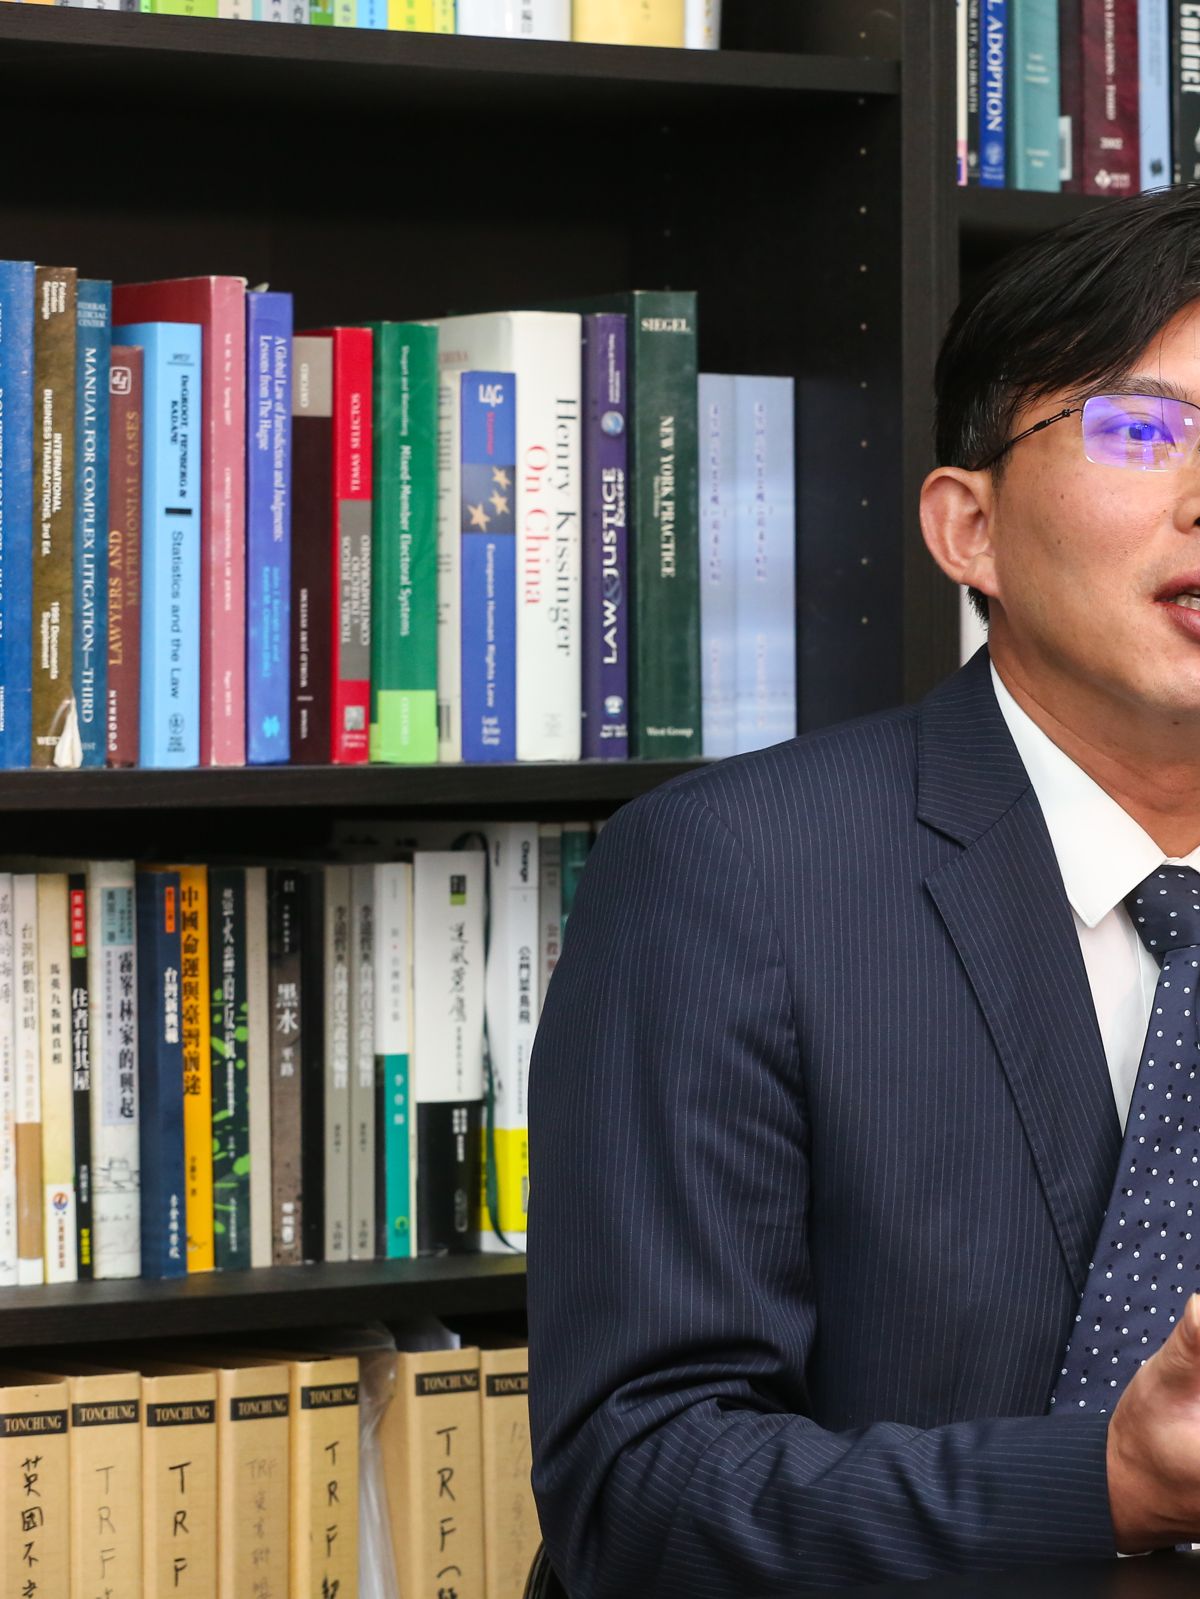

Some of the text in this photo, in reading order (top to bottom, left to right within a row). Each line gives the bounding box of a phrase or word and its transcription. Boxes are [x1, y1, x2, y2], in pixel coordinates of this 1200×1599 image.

[987, 15, 1003, 132] ADOPTION
[50, 281, 59, 313] Gordon
[58, 281, 67, 313] Folsom
[274, 335, 286, 345] A
[274, 346, 287, 379] Global
[84, 347, 97, 425] MANUAL
[256, 335, 272, 451] Lessons from The Hague
[274, 380, 286, 399] Law
[274, 402, 287, 413] of
[300, 363, 310, 408] OXFORD
[84, 430, 97, 462] FOR
[170, 400, 179, 444] KADANE
[274, 414, 286, 469] Jurisdiction
[350, 393, 361, 492] TEMAS SELECTOS
[41, 389, 52, 557] BUSINESS TRANSACTIONS, 3rd Ed.
[52, 432, 62, 513] INTERNATIONAL
[273, 470, 285, 488] and
[660, 415, 676, 578] NEW YORK PRACTICE
[83, 466, 96, 548] COMPLEX
[125, 411, 139, 606] MATRIMONIAL CASES
[525, 444, 550, 605] On China
[547, 397, 577, 656] Henry Kissinger
[602, 467, 618, 579] JUSTICE
[398, 444, 411, 636] Mixed-Member Electoral Systems
[109, 530, 123, 666] LAWYERS AND
[170, 530, 184, 699] Statistics and the Law
[484, 543, 496, 708] European Human Rights Law
[40, 611, 50, 669] Supplement
[50, 625, 59, 680] Documents
[603, 599, 617, 664] LAW
[520, 841, 530, 883] Change
[275, 982, 299, 1034] 黑水
[71, 987, 90, 1091] 住者有其屋
[280, 1047, 294, 1077] 平路
[238, 1399, 287, 1417] TONCHUNG
[310, 1387, 356, 1404] TONCHUNG
[423, 1374, 477, 1391] TONCHUNG
[494, 1376, 528, 1392] TONCH
[4, 1415, 62, 1433] TONCHUNG
[79, 1404, 135, 1422] TONCHUNG
[155, 1404, 210, 1422] TONCHUNG
[168, 1461, 192, 1588] TRF
